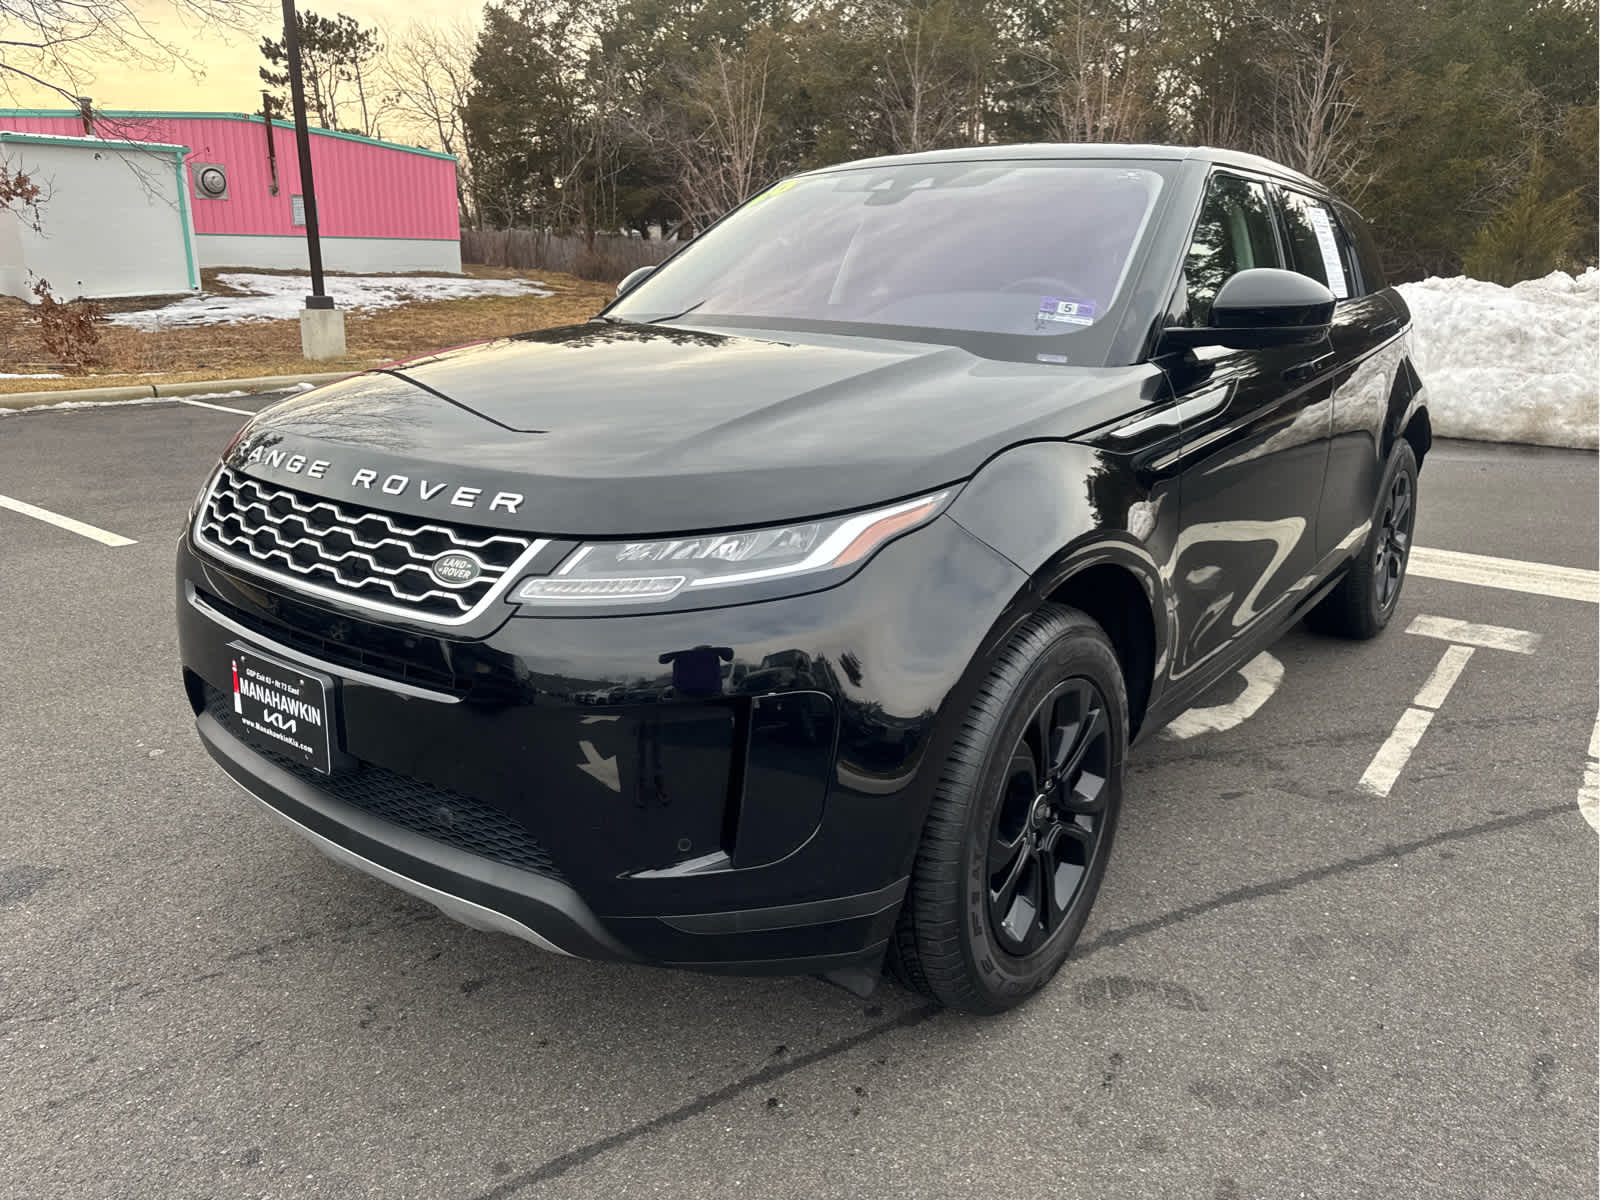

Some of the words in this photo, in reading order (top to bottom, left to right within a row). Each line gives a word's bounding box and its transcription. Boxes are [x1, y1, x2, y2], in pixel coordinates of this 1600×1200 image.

[1063, 303, 1073, 313] 5
[238, 439, 331, 479] RANGE
[351, 468, 528, 514] ROVER
[442, 558, 468, 569] LAND
[441, 566, 472, 579] ROVER
[239, 677, 321, 727] MANAHAWKIN
